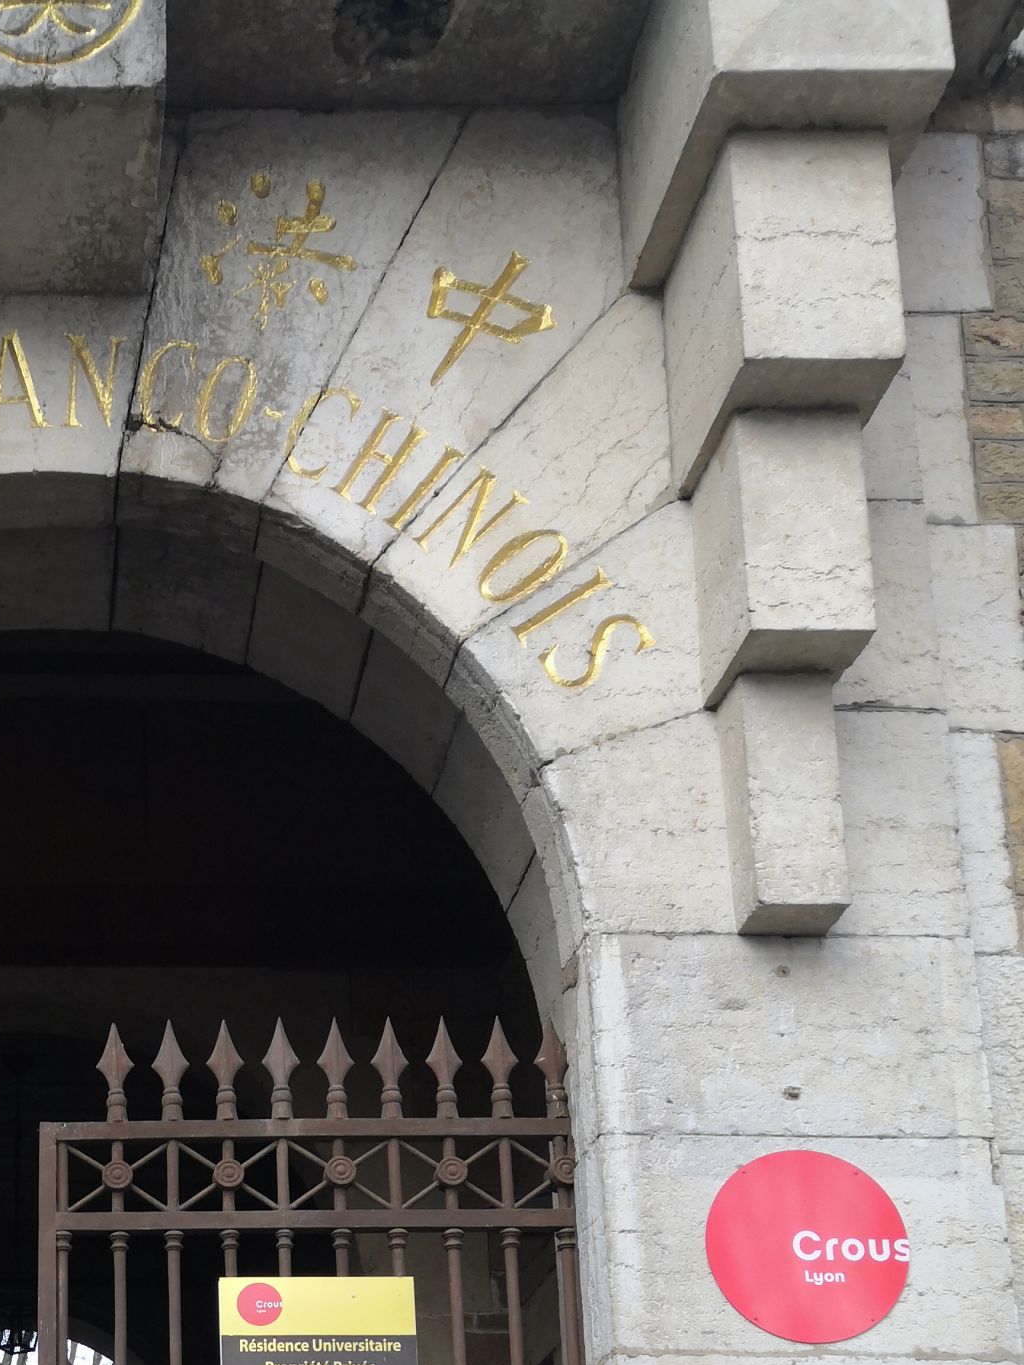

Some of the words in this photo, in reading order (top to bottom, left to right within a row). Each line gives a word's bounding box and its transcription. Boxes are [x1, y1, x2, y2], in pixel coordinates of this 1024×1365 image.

[792, 1230, 910, 1262] Crous
[804, 1269, 846, 1286] Lyon
[239, 1338, 309, 1352] Résidence
[312, 1338, 401, 1352] Universitaire
